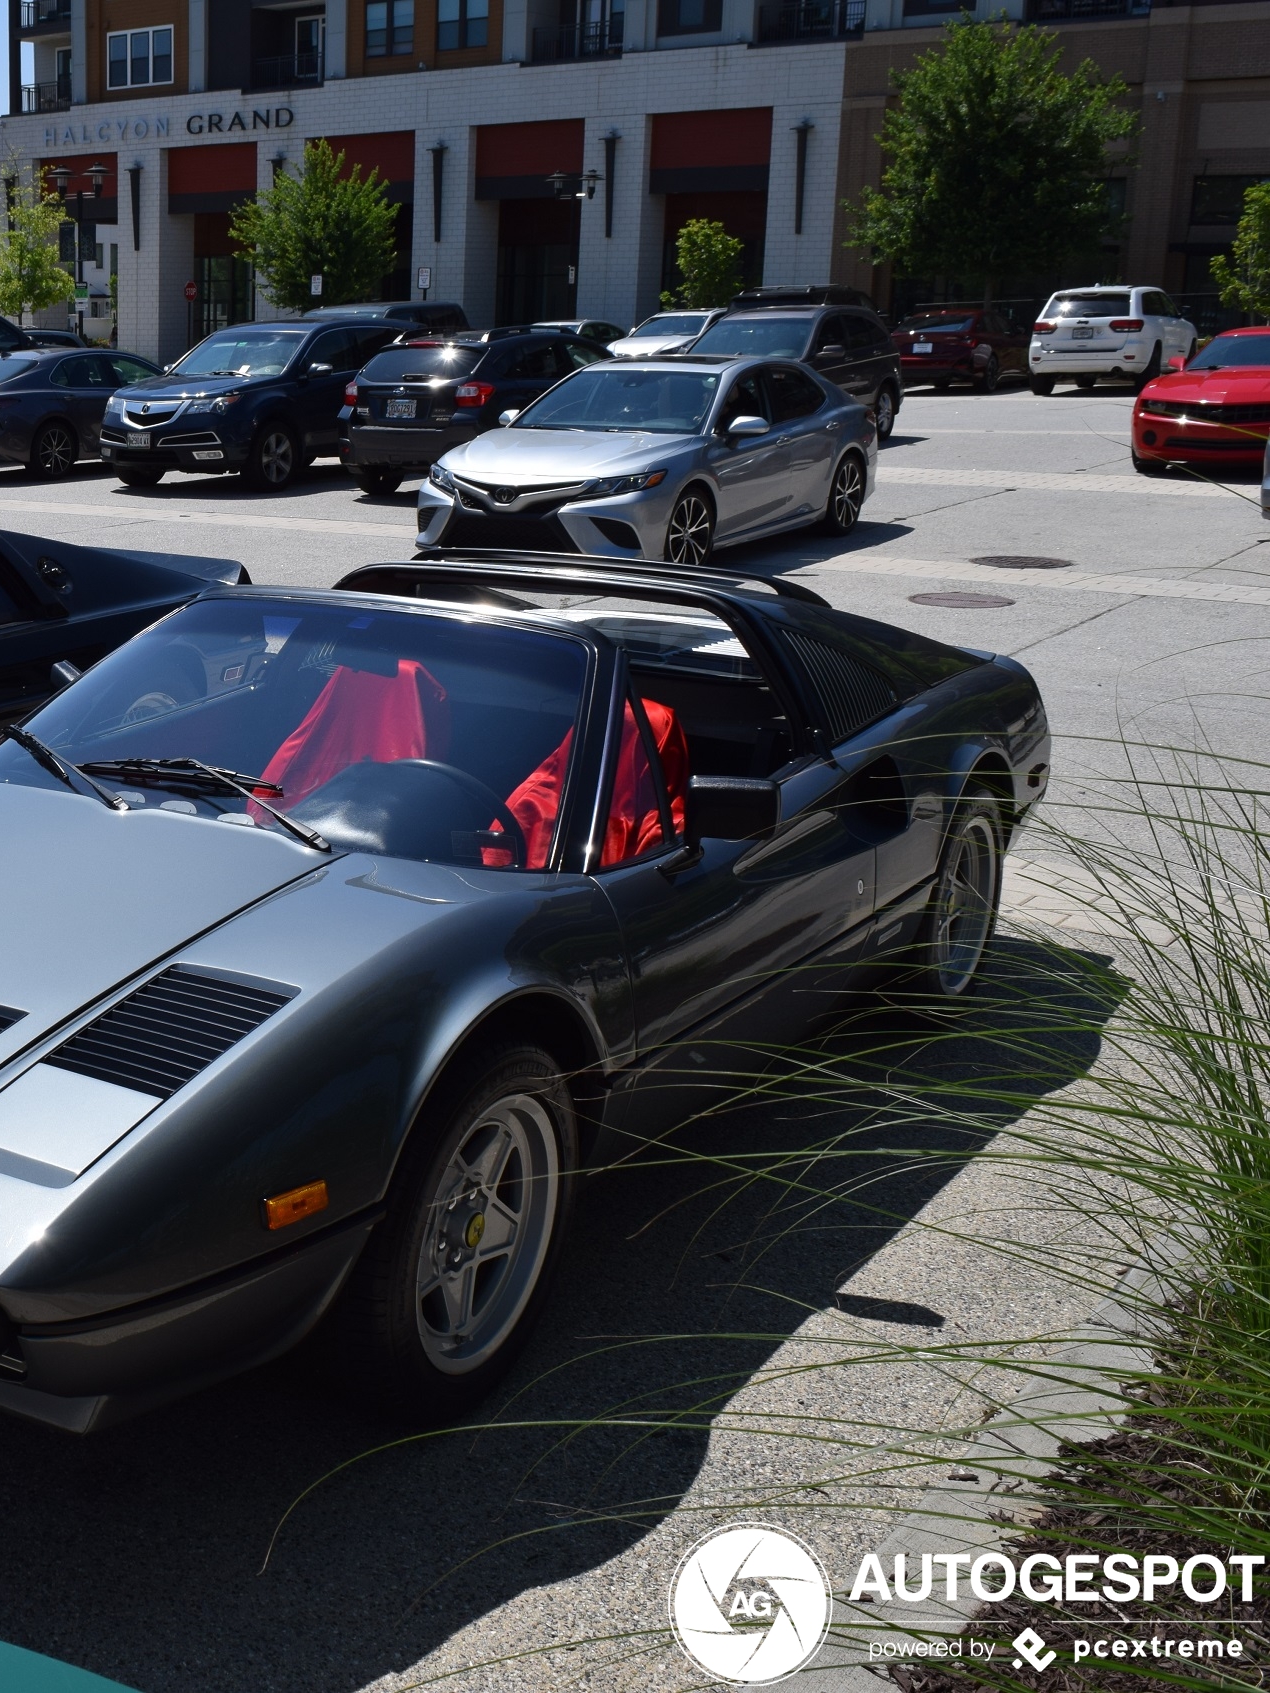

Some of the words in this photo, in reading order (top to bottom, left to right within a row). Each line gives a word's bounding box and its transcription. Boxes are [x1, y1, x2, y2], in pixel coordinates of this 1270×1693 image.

[43, 117, 170, 147] HALCYON
[186, 107, 294, 135] GRAND
[185, 287, 197, 296] STOP
